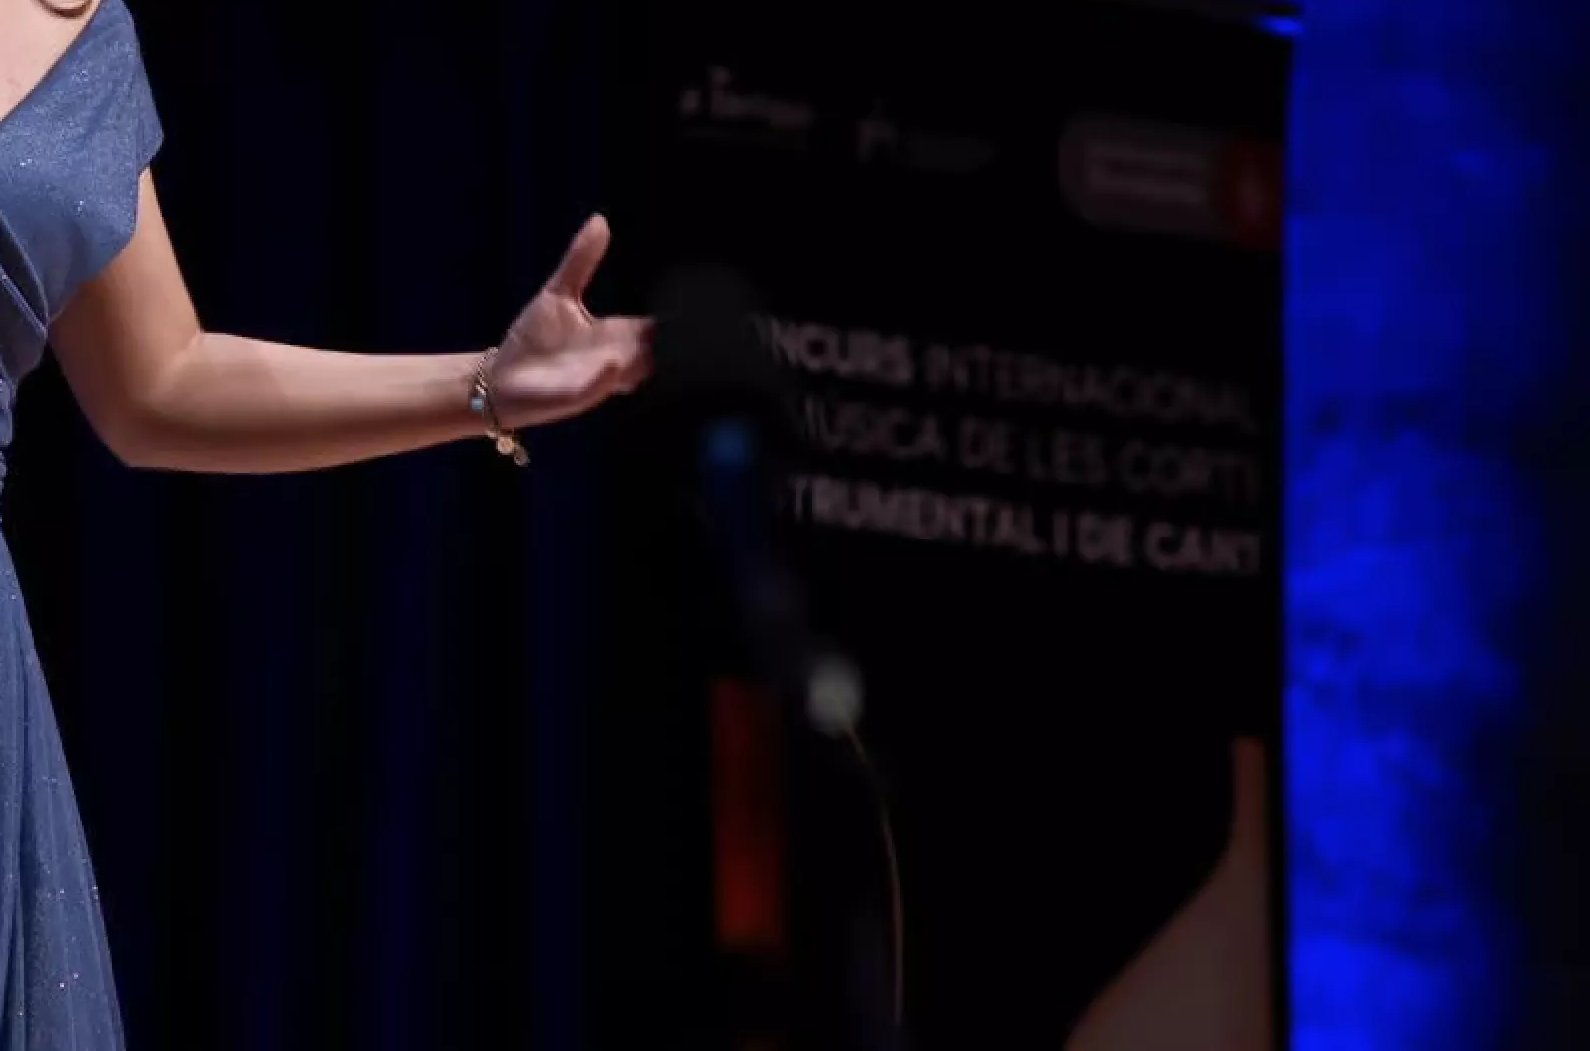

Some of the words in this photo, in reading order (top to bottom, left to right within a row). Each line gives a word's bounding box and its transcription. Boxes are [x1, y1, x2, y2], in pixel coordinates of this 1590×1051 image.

[757, 313, 914, 384] NCURS
[921, 340, 1256, 432] INTERNACIONAL
[959, 415, 1014, 474] DE
[784, 472, 1048, 556] TRUMENTAL
[1076, 511, 1134, 567] DE
[1142, 520, 1260, 576] CANT
